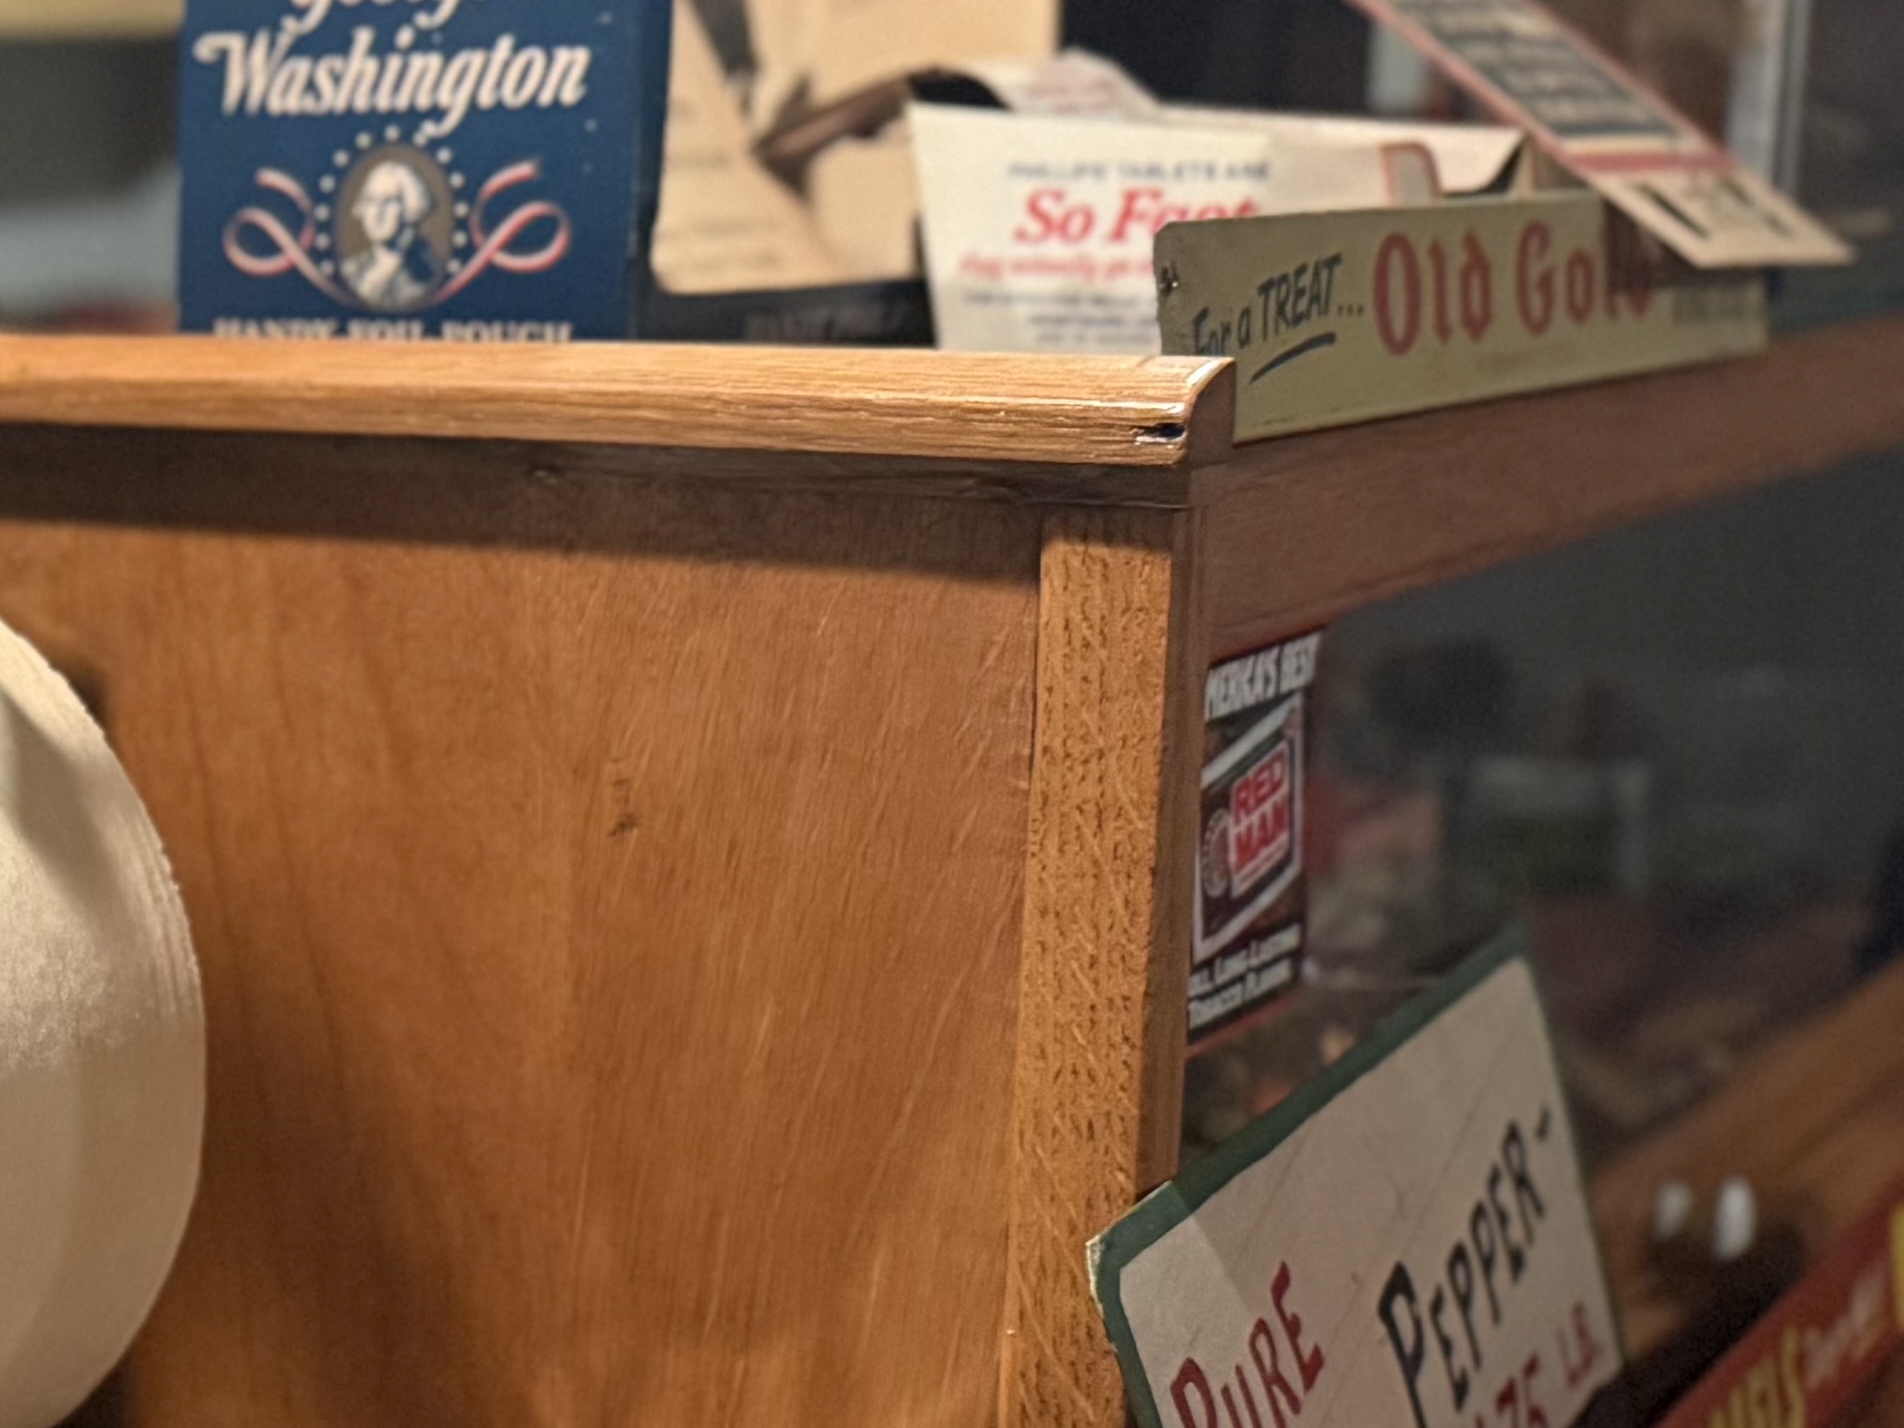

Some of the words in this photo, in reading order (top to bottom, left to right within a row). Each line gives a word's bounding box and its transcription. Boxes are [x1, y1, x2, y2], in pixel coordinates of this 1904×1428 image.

[193, 25, 592, 138] Washington
[1015, 188, 1096, 245] So
[1192, 306, 1233, 356] For
[1236, 304, 1252, 349] a
[1371, 227, 1492, 357] Old
[1233, 746, 1288, 820] RED
[1233, 787, 1291, 871] MAN
